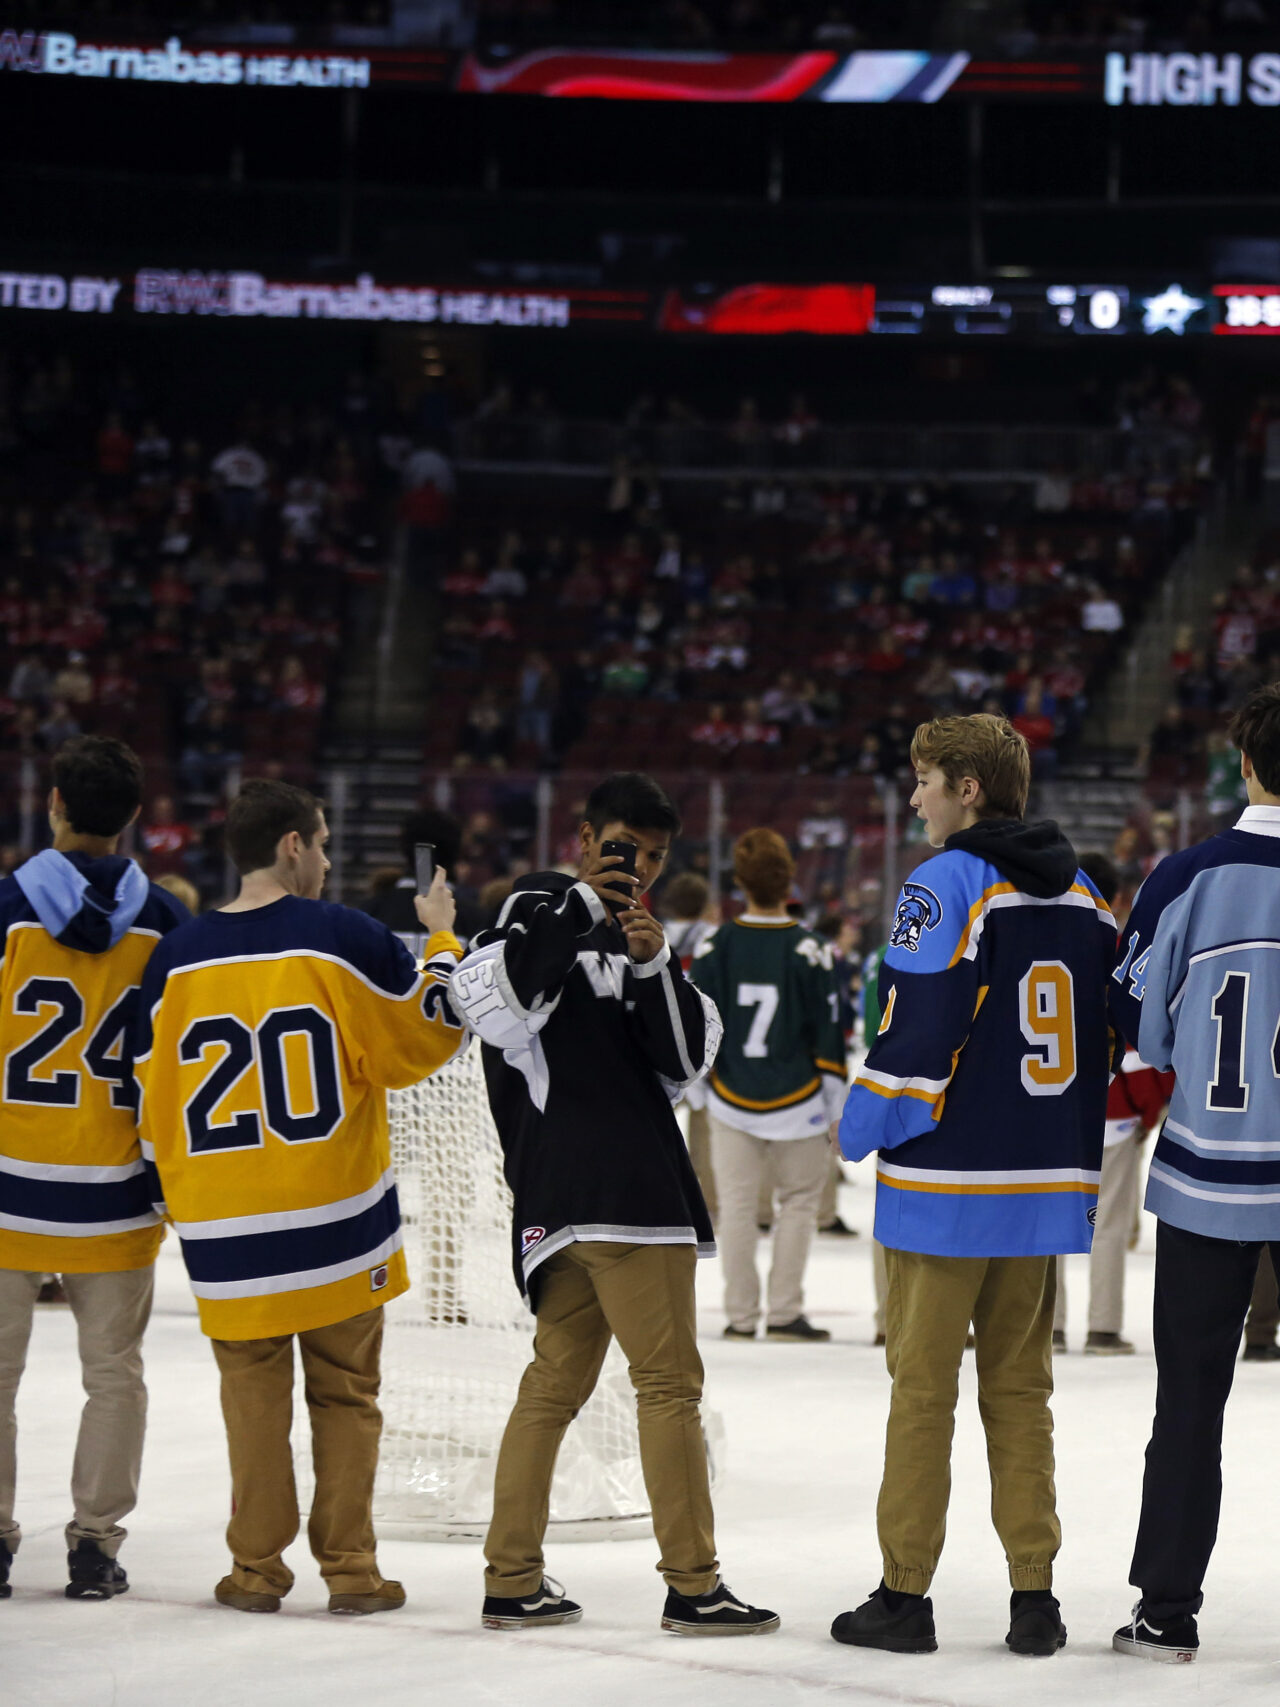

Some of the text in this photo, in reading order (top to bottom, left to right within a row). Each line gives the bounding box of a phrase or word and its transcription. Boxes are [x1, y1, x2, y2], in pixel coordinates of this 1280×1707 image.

[245, 55, 371, 88] HEALTH
[1104, 53, 1243, 106] HIGH
[69, 274, 121, 314] BY
[441, 293, 570, 328] HEALTH
[1089, 289, 1121, 330] 0
[1112, 930, 1153, 1001] 14
[3, 975, 146, 1110] 24
[737, 983, 779, 1058] 7
[1018, 960, 1077, 1096] 9
[178, 1003, 345, 1156] 20
